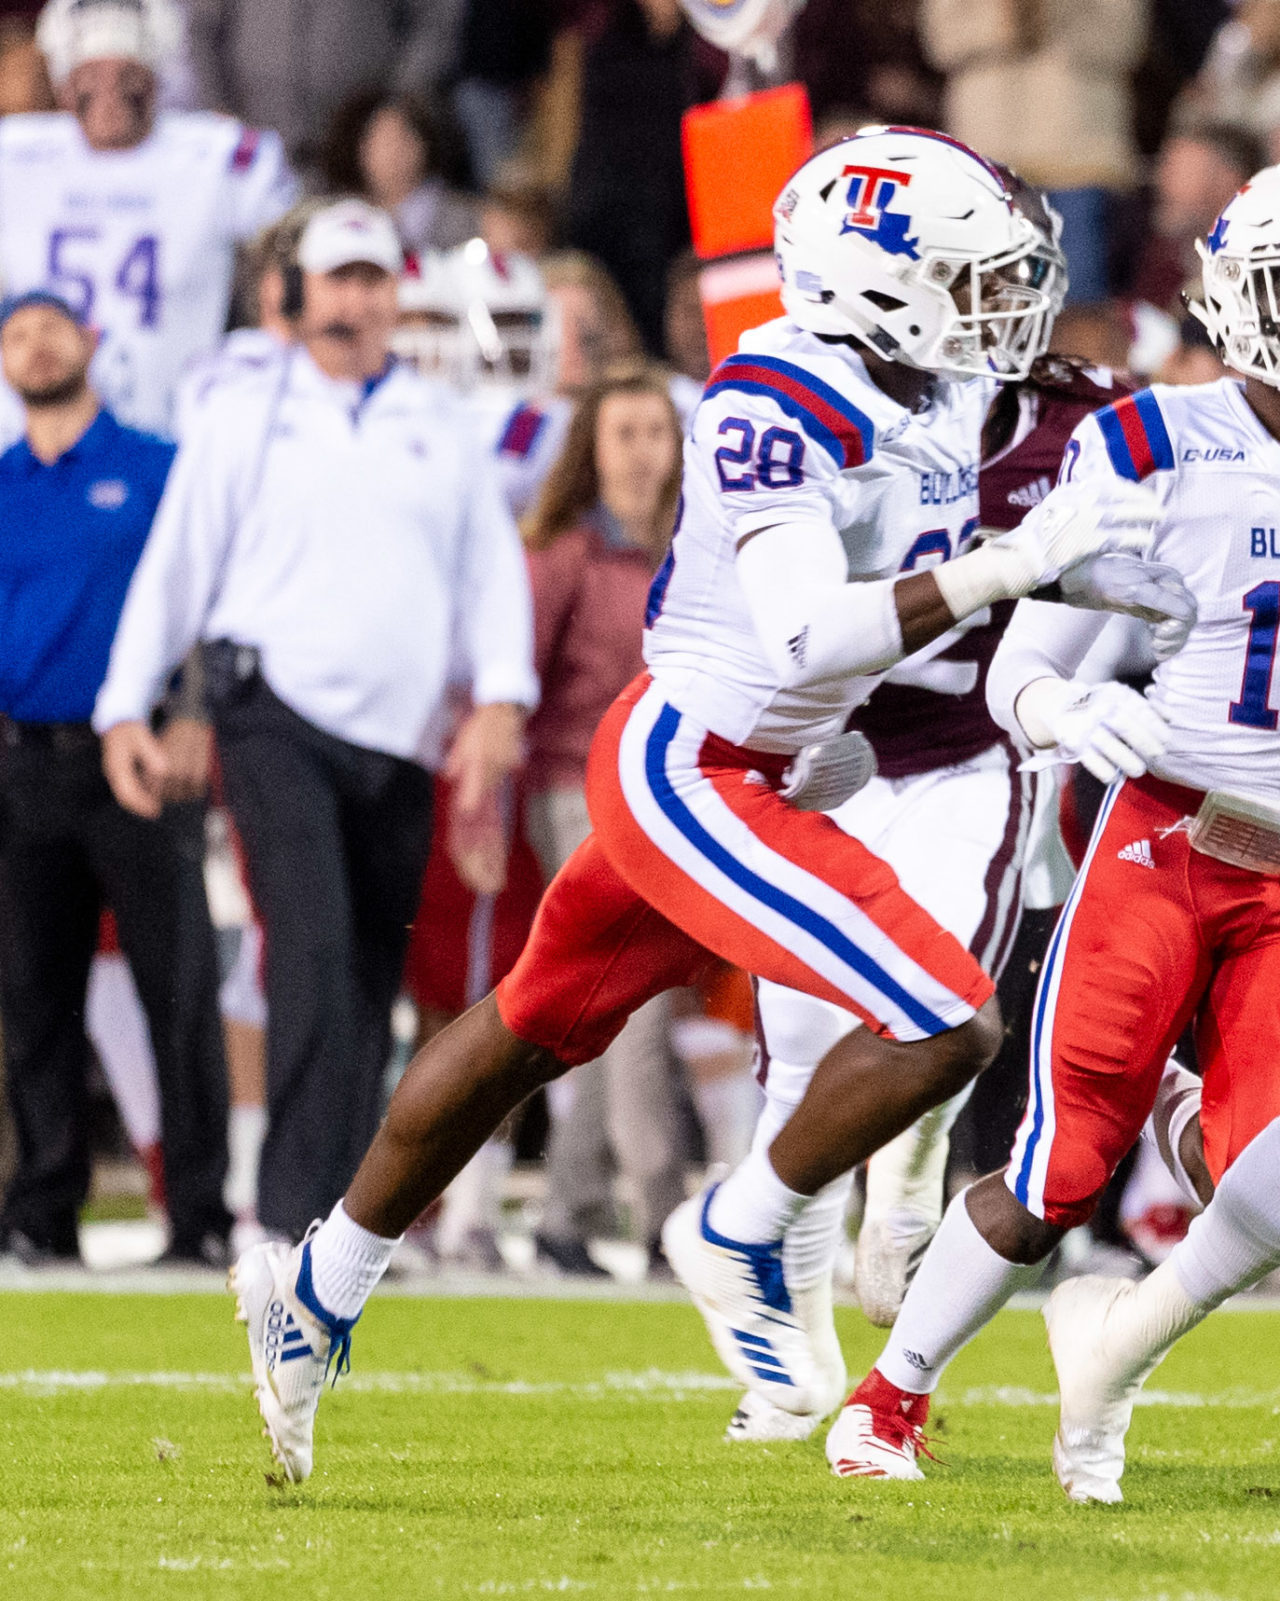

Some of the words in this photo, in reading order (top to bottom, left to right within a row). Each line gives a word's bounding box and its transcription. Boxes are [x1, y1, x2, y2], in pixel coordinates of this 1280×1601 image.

[842, 164, 912, 228] T
[46, 226, 160, 328] 54
[714, 416, 806, 492] 28
[1117, 851, 1155, 869] adidas
[265, 1299, 284, 1373] adidas
